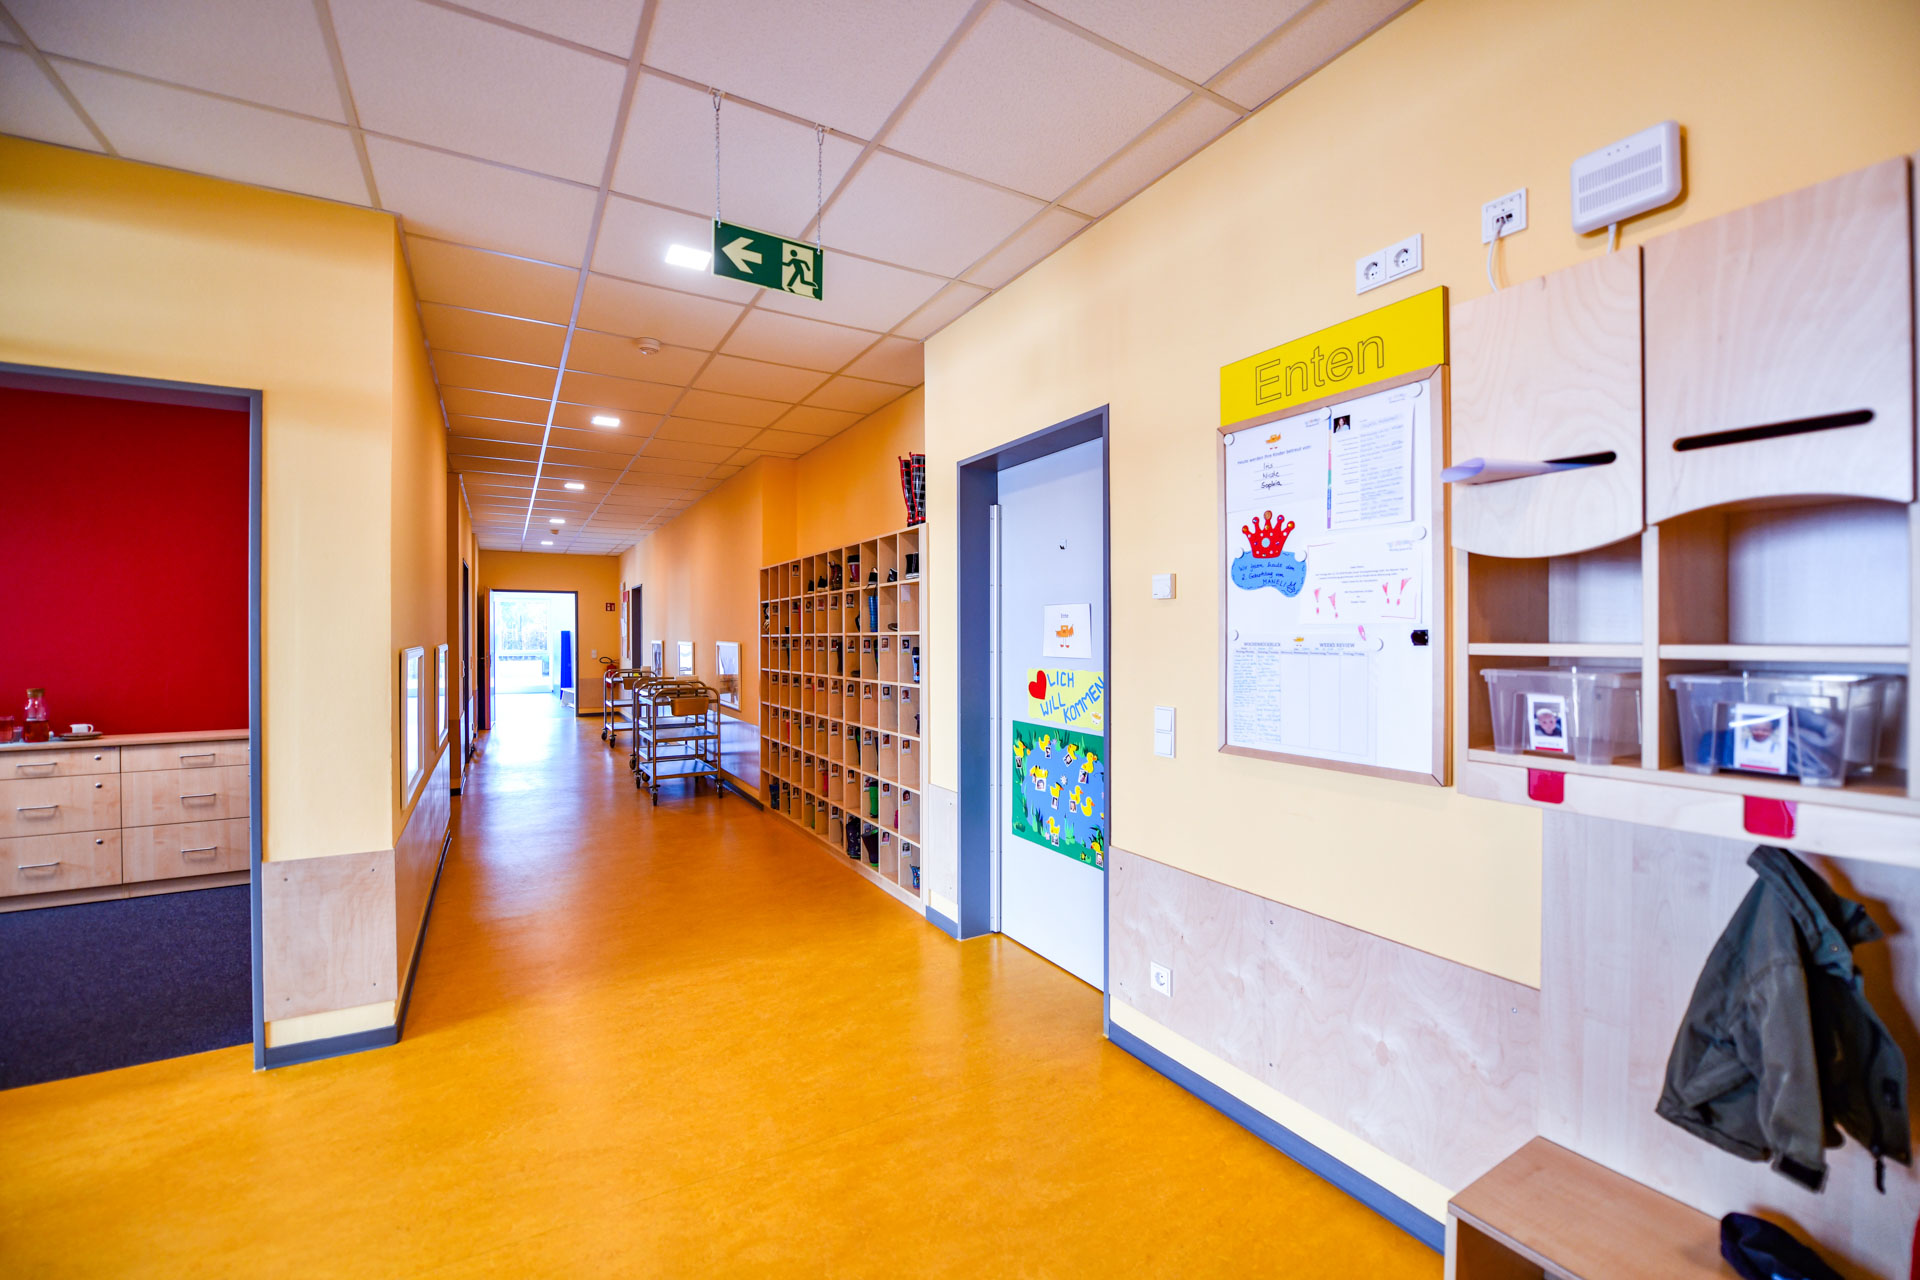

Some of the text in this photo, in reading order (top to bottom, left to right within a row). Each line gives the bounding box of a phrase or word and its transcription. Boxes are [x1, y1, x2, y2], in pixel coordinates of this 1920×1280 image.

[1255, 335, 1385, 406] Enten
[1047, 670, 1074, 688] LICH
[1040, 692, 1066, 717] WILL
[1063, 676, 1104, 724] KOMMEN
